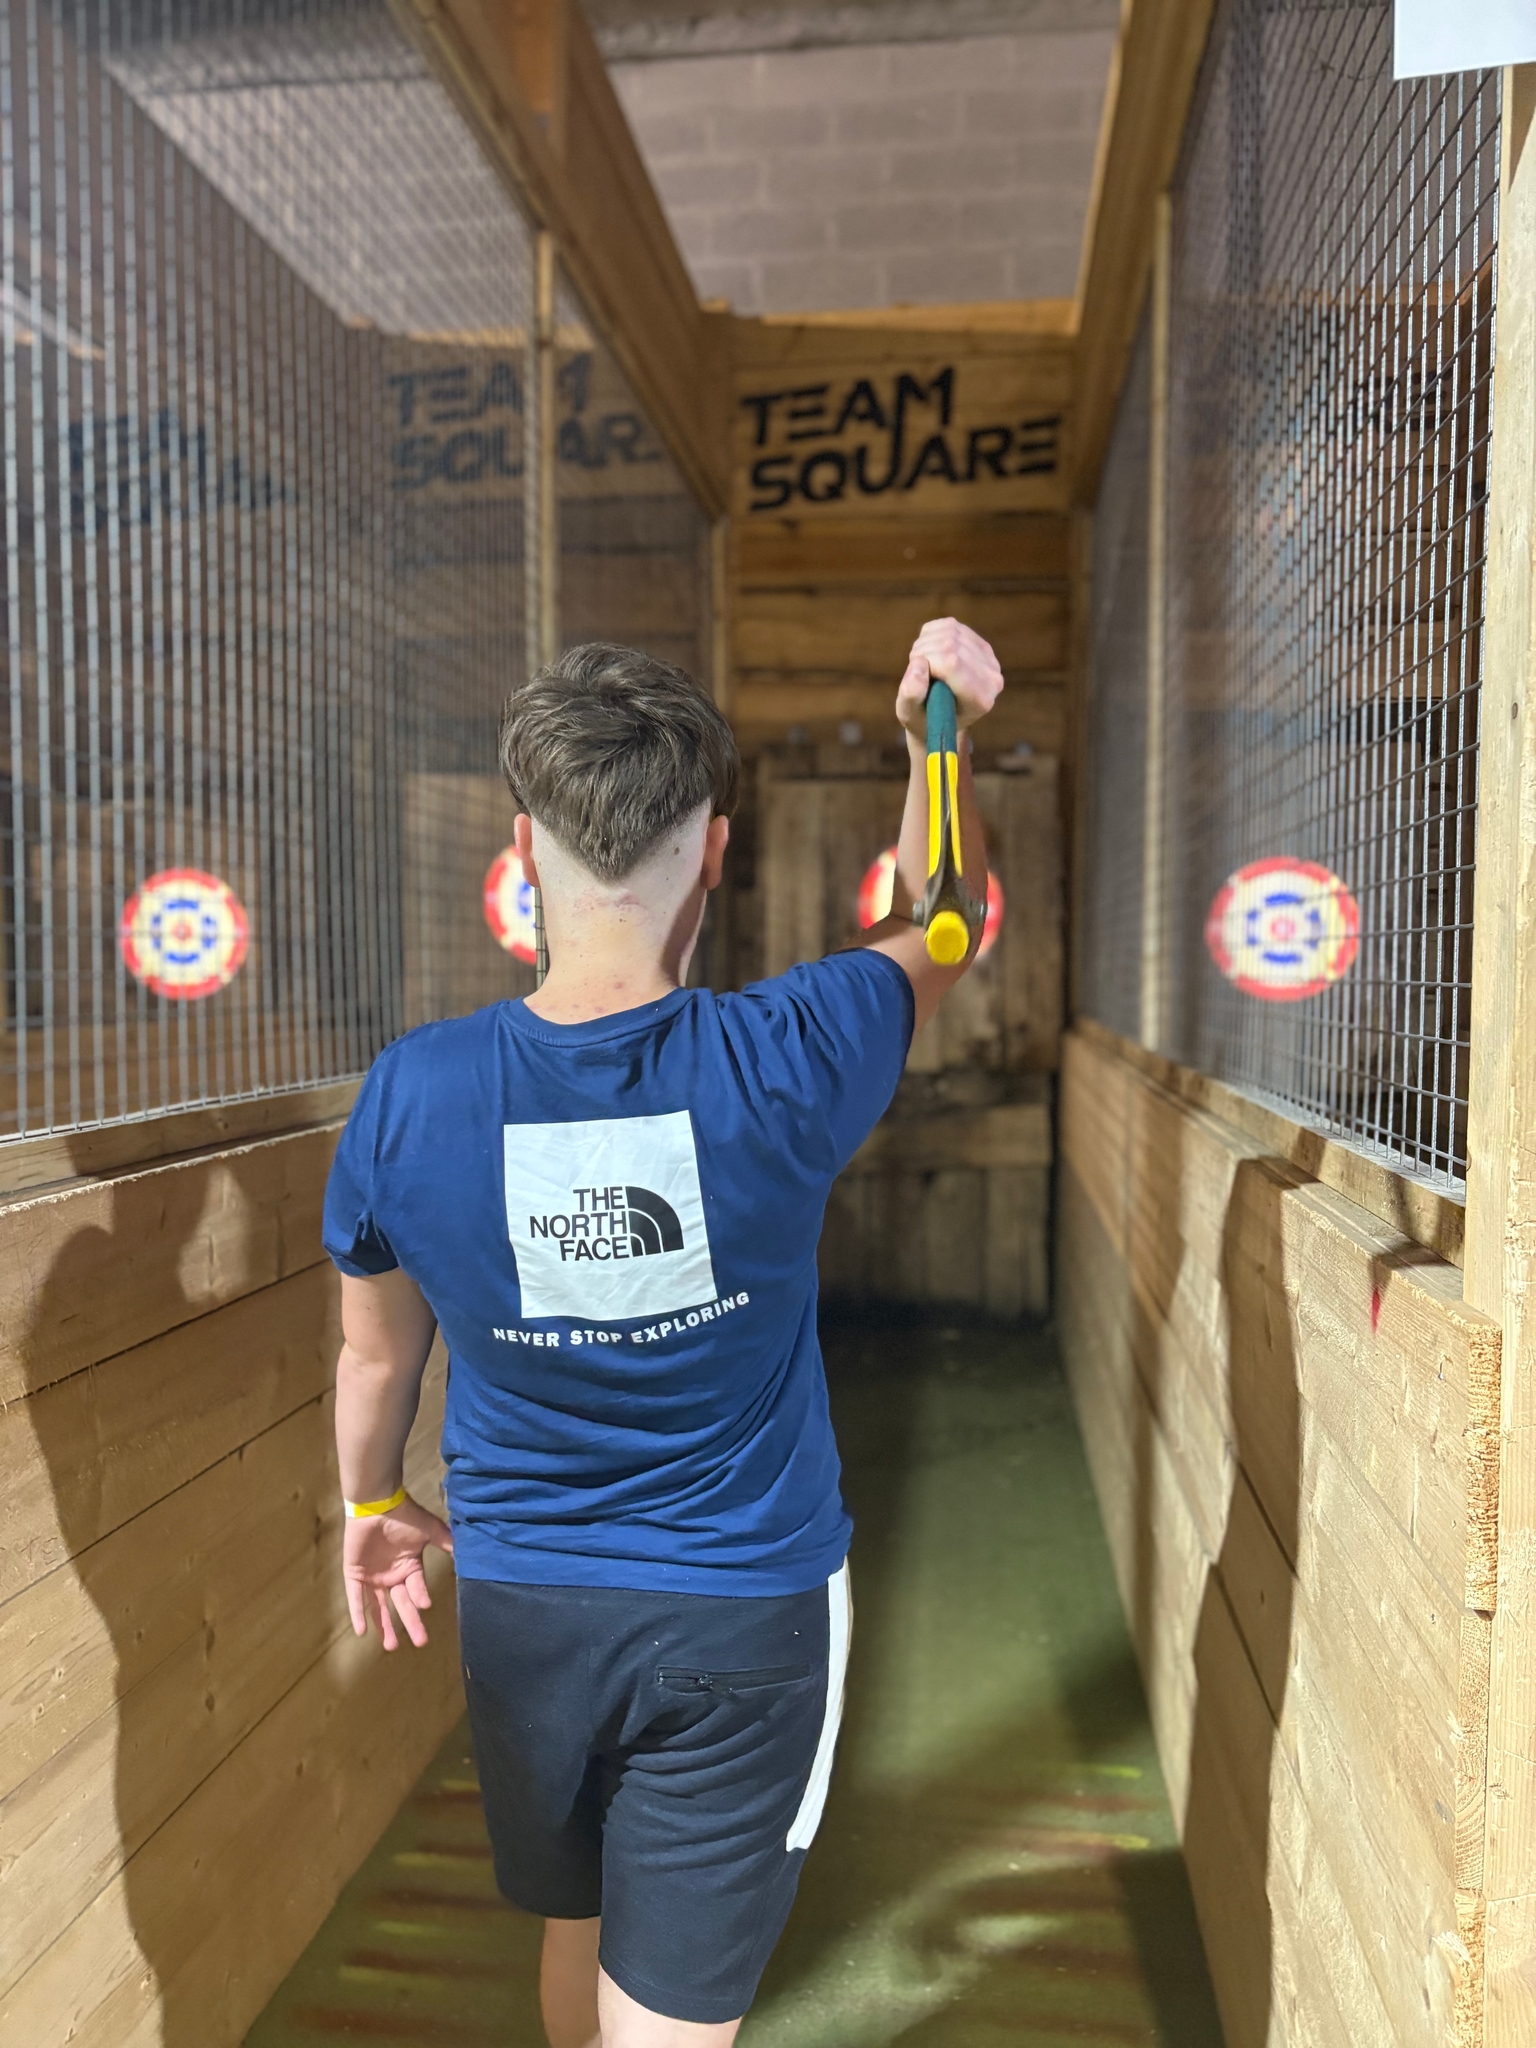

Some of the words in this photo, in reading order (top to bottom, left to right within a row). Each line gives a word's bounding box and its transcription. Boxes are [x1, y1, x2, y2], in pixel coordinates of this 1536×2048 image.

[741, 366, 956, 447] TEAM
[391, 413, 664, 491] SQUAR
[750, 413, 1061, 512] SQUARE
[529, 1210, 628, 1239] NORTH
[572, 1185, 626, 1213] THE
[559, 1236, 630, 1262] FACE
[492, 1327, 560, 1347] NEVER
[569, 1329, 623, 1346] STOP
[630, 1291, 750, 1344] EXPLORING
